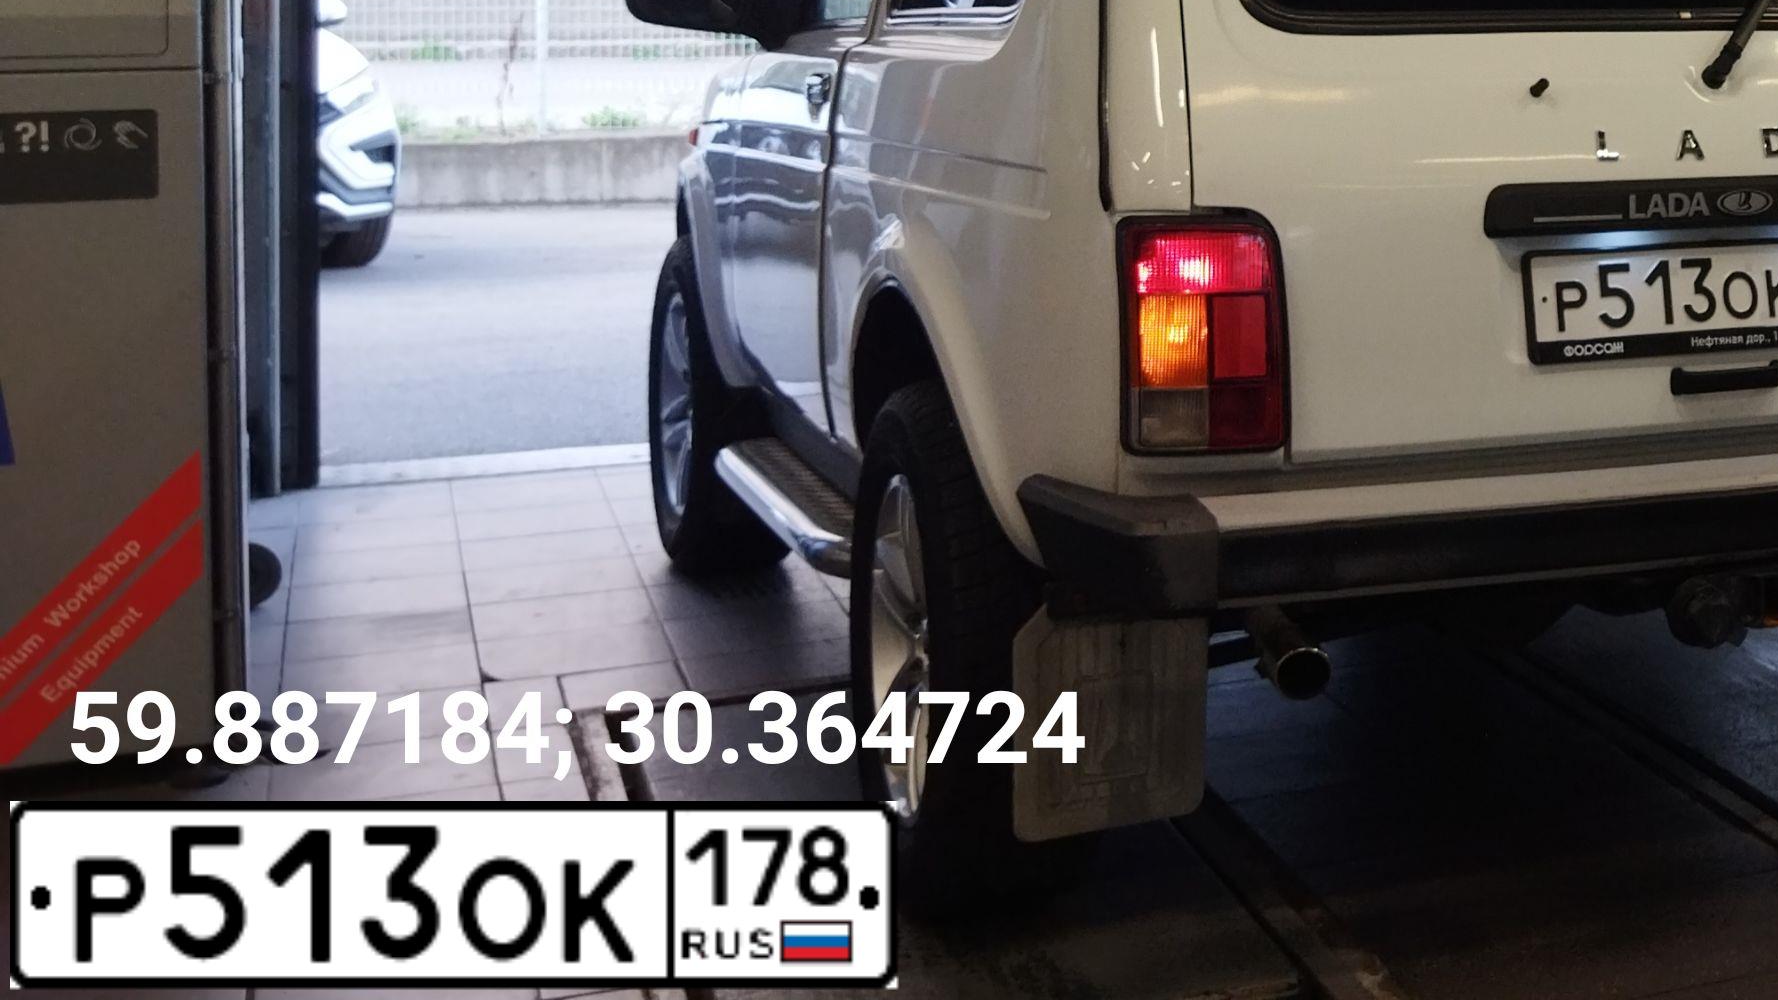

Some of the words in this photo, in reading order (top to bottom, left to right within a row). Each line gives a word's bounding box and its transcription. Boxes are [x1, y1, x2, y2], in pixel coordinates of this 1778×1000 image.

[1628, 191, 1710, 219] LADA
[44, 539, 142, 628] Workshop
[40, 606, 144, 703] Equipment
